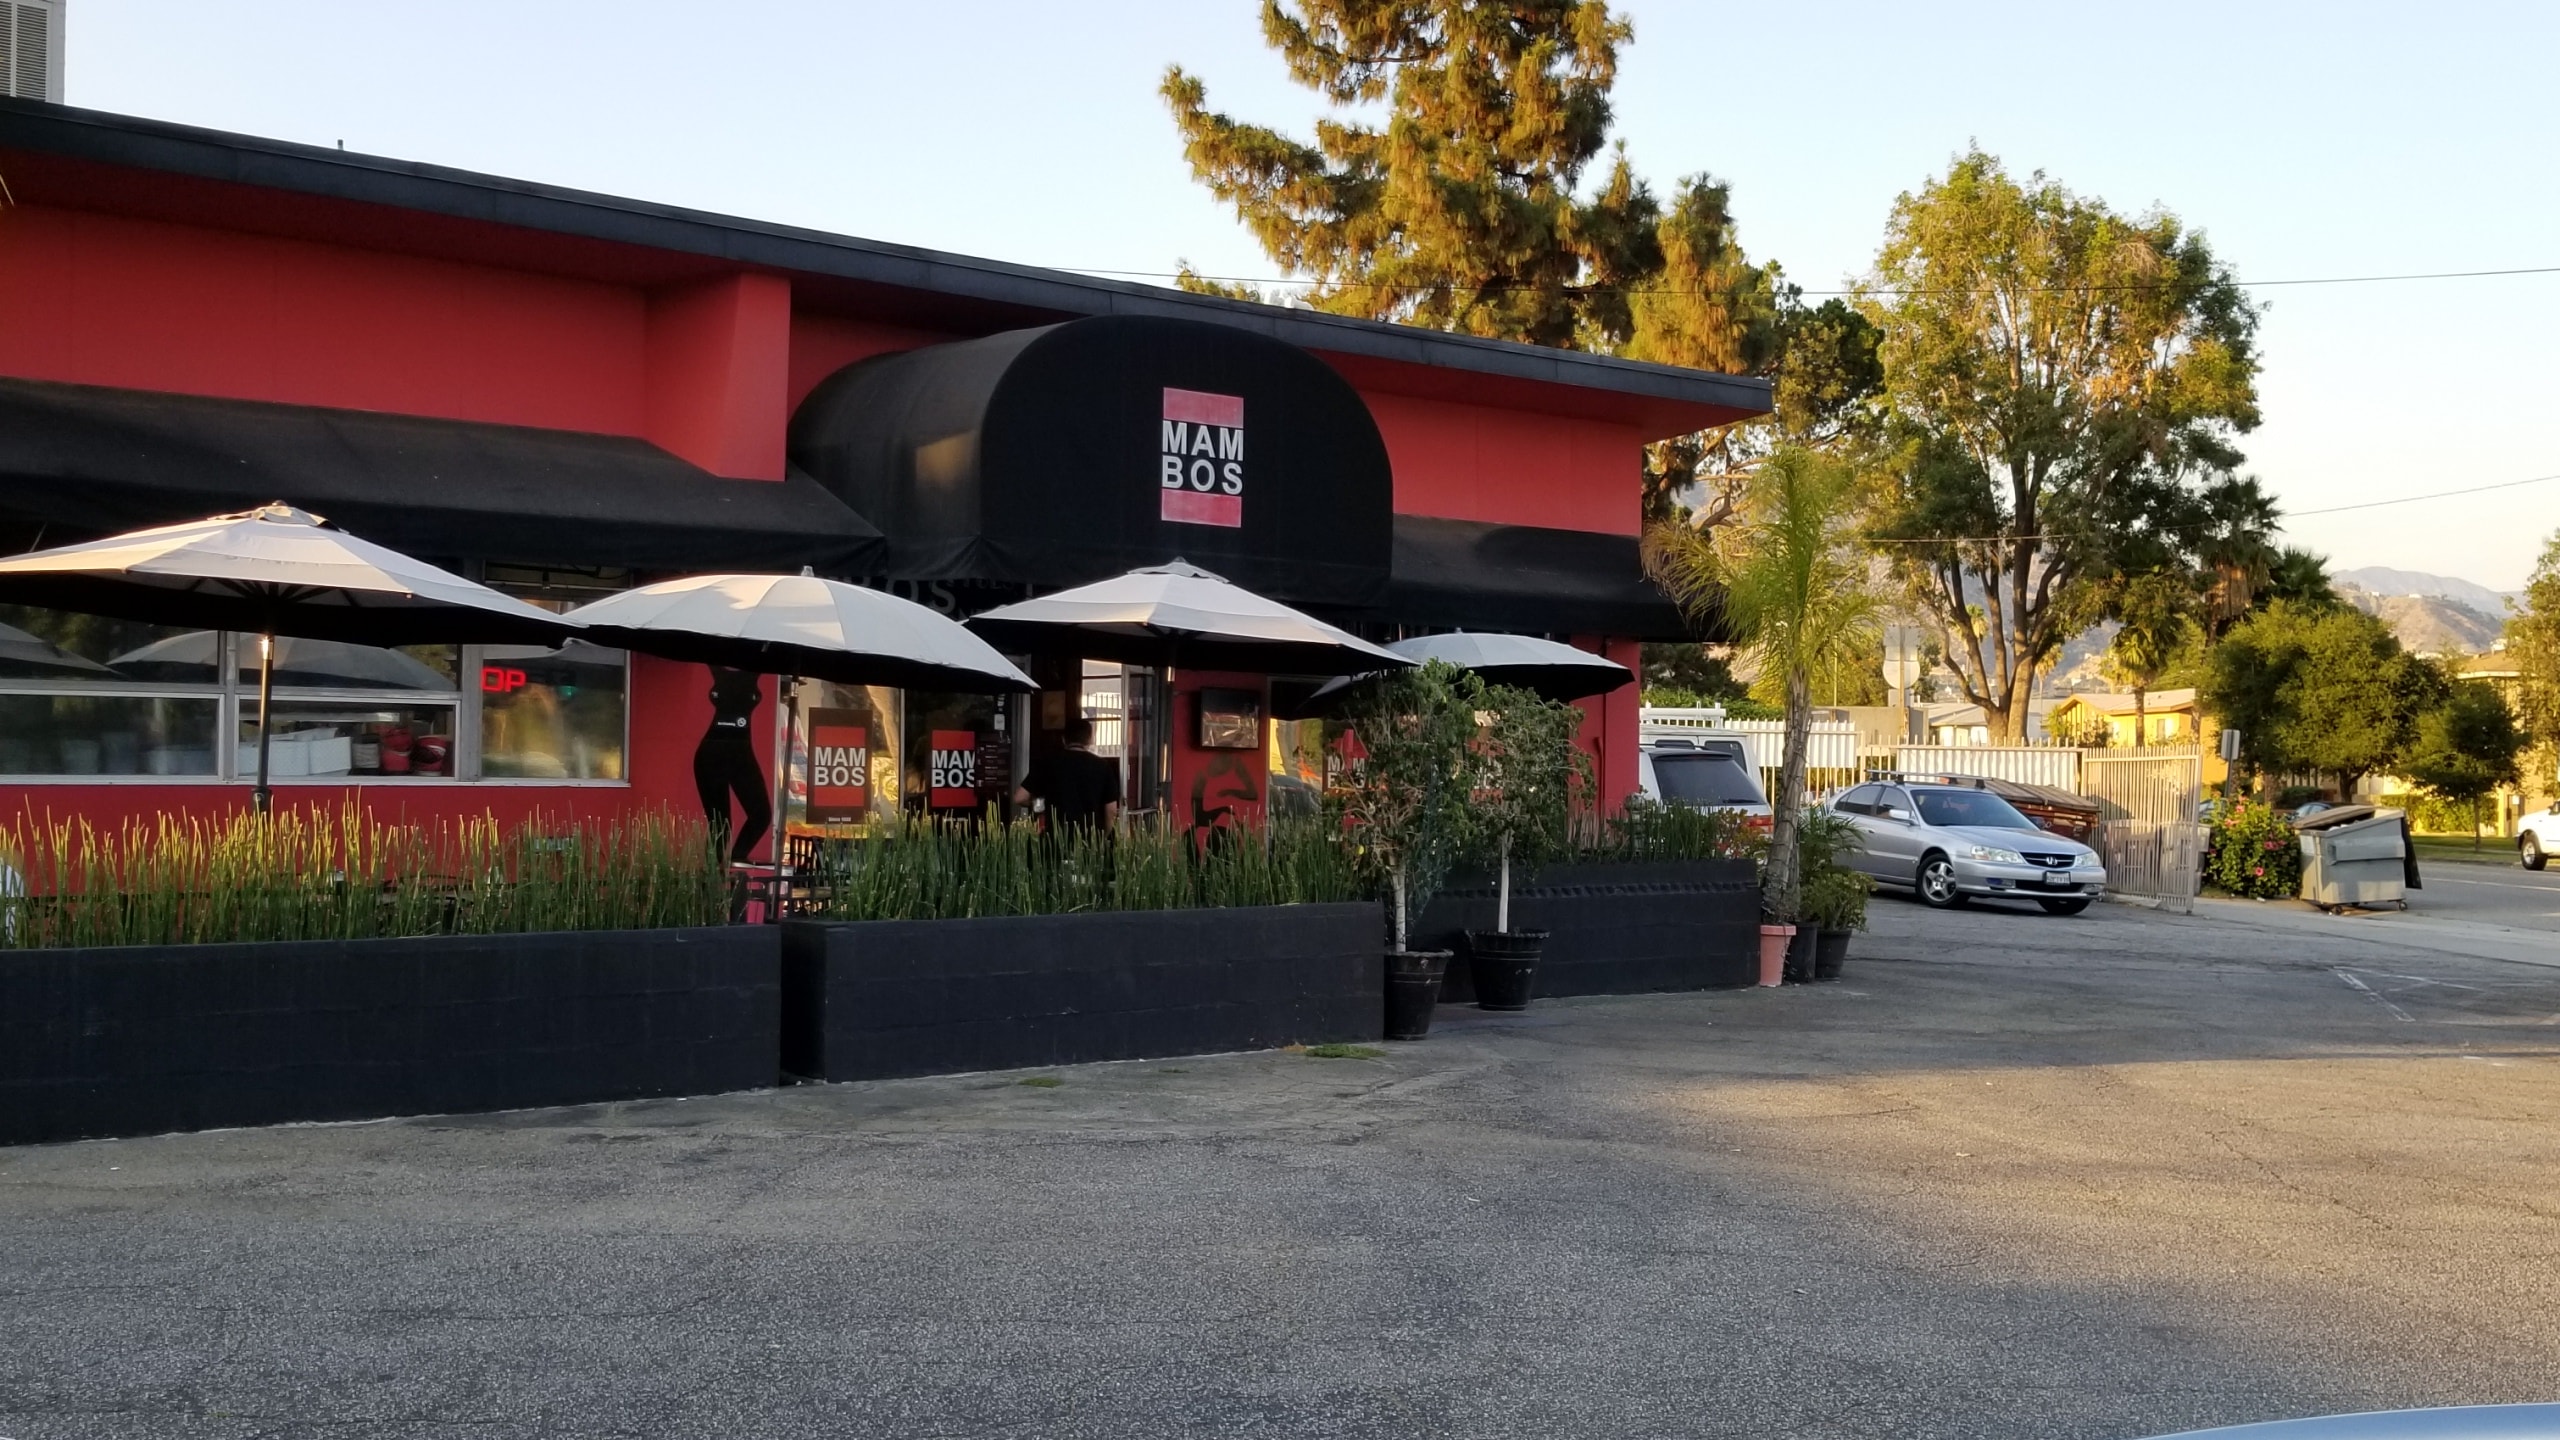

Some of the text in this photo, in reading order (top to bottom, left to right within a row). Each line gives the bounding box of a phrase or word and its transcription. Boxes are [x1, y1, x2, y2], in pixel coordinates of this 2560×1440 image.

[1162, 420, 1244, 461] MAM
[1162, 455, 1243, 495] BOS
[815, 746, 866, 767] MAM
[932, 750, 976, 769] MAM
[814, 766, 866, 787] BOS
